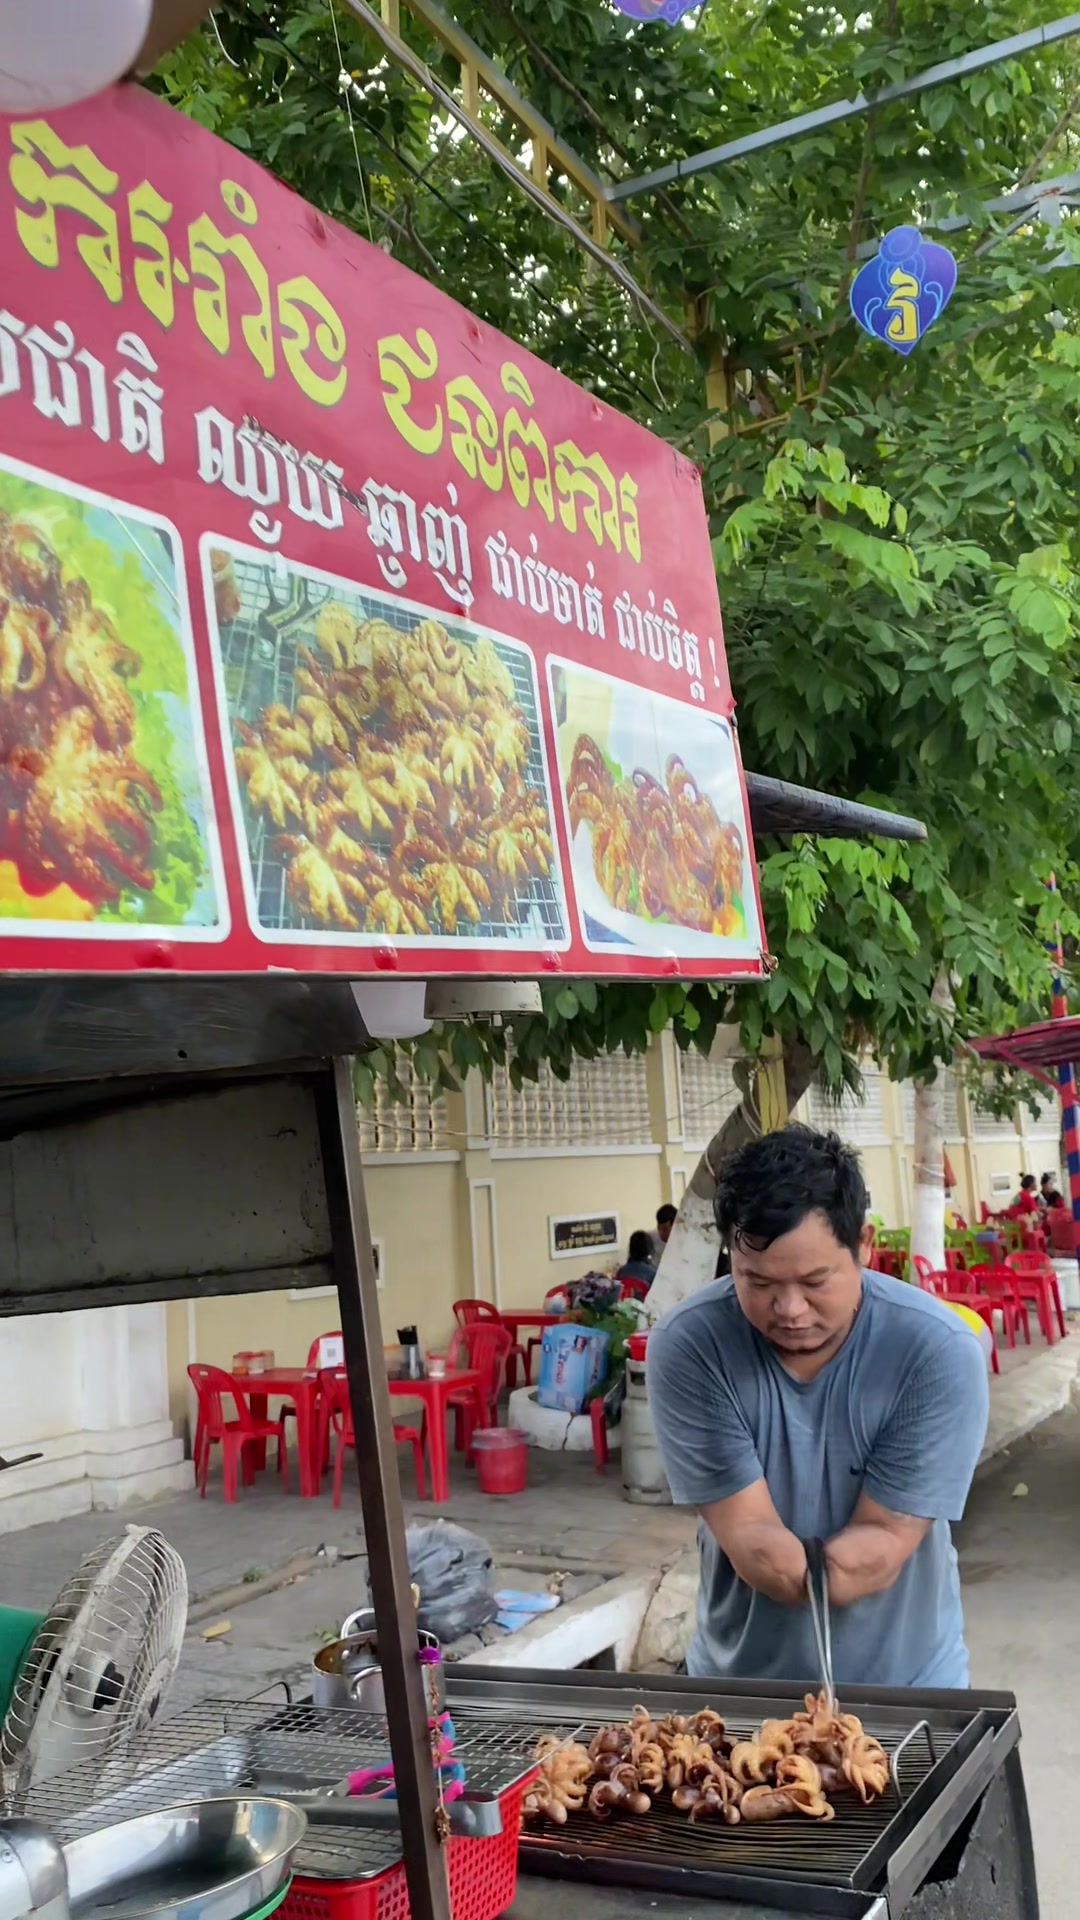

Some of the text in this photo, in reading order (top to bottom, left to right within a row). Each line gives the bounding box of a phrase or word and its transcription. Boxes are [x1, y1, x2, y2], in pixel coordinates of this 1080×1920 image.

[377, 328, 641, 563] ជនពិការ
[484, 530, 605, 639] ជាប់មាត់
[613, 590, 705, 702] ជាប់ចិត្ត
